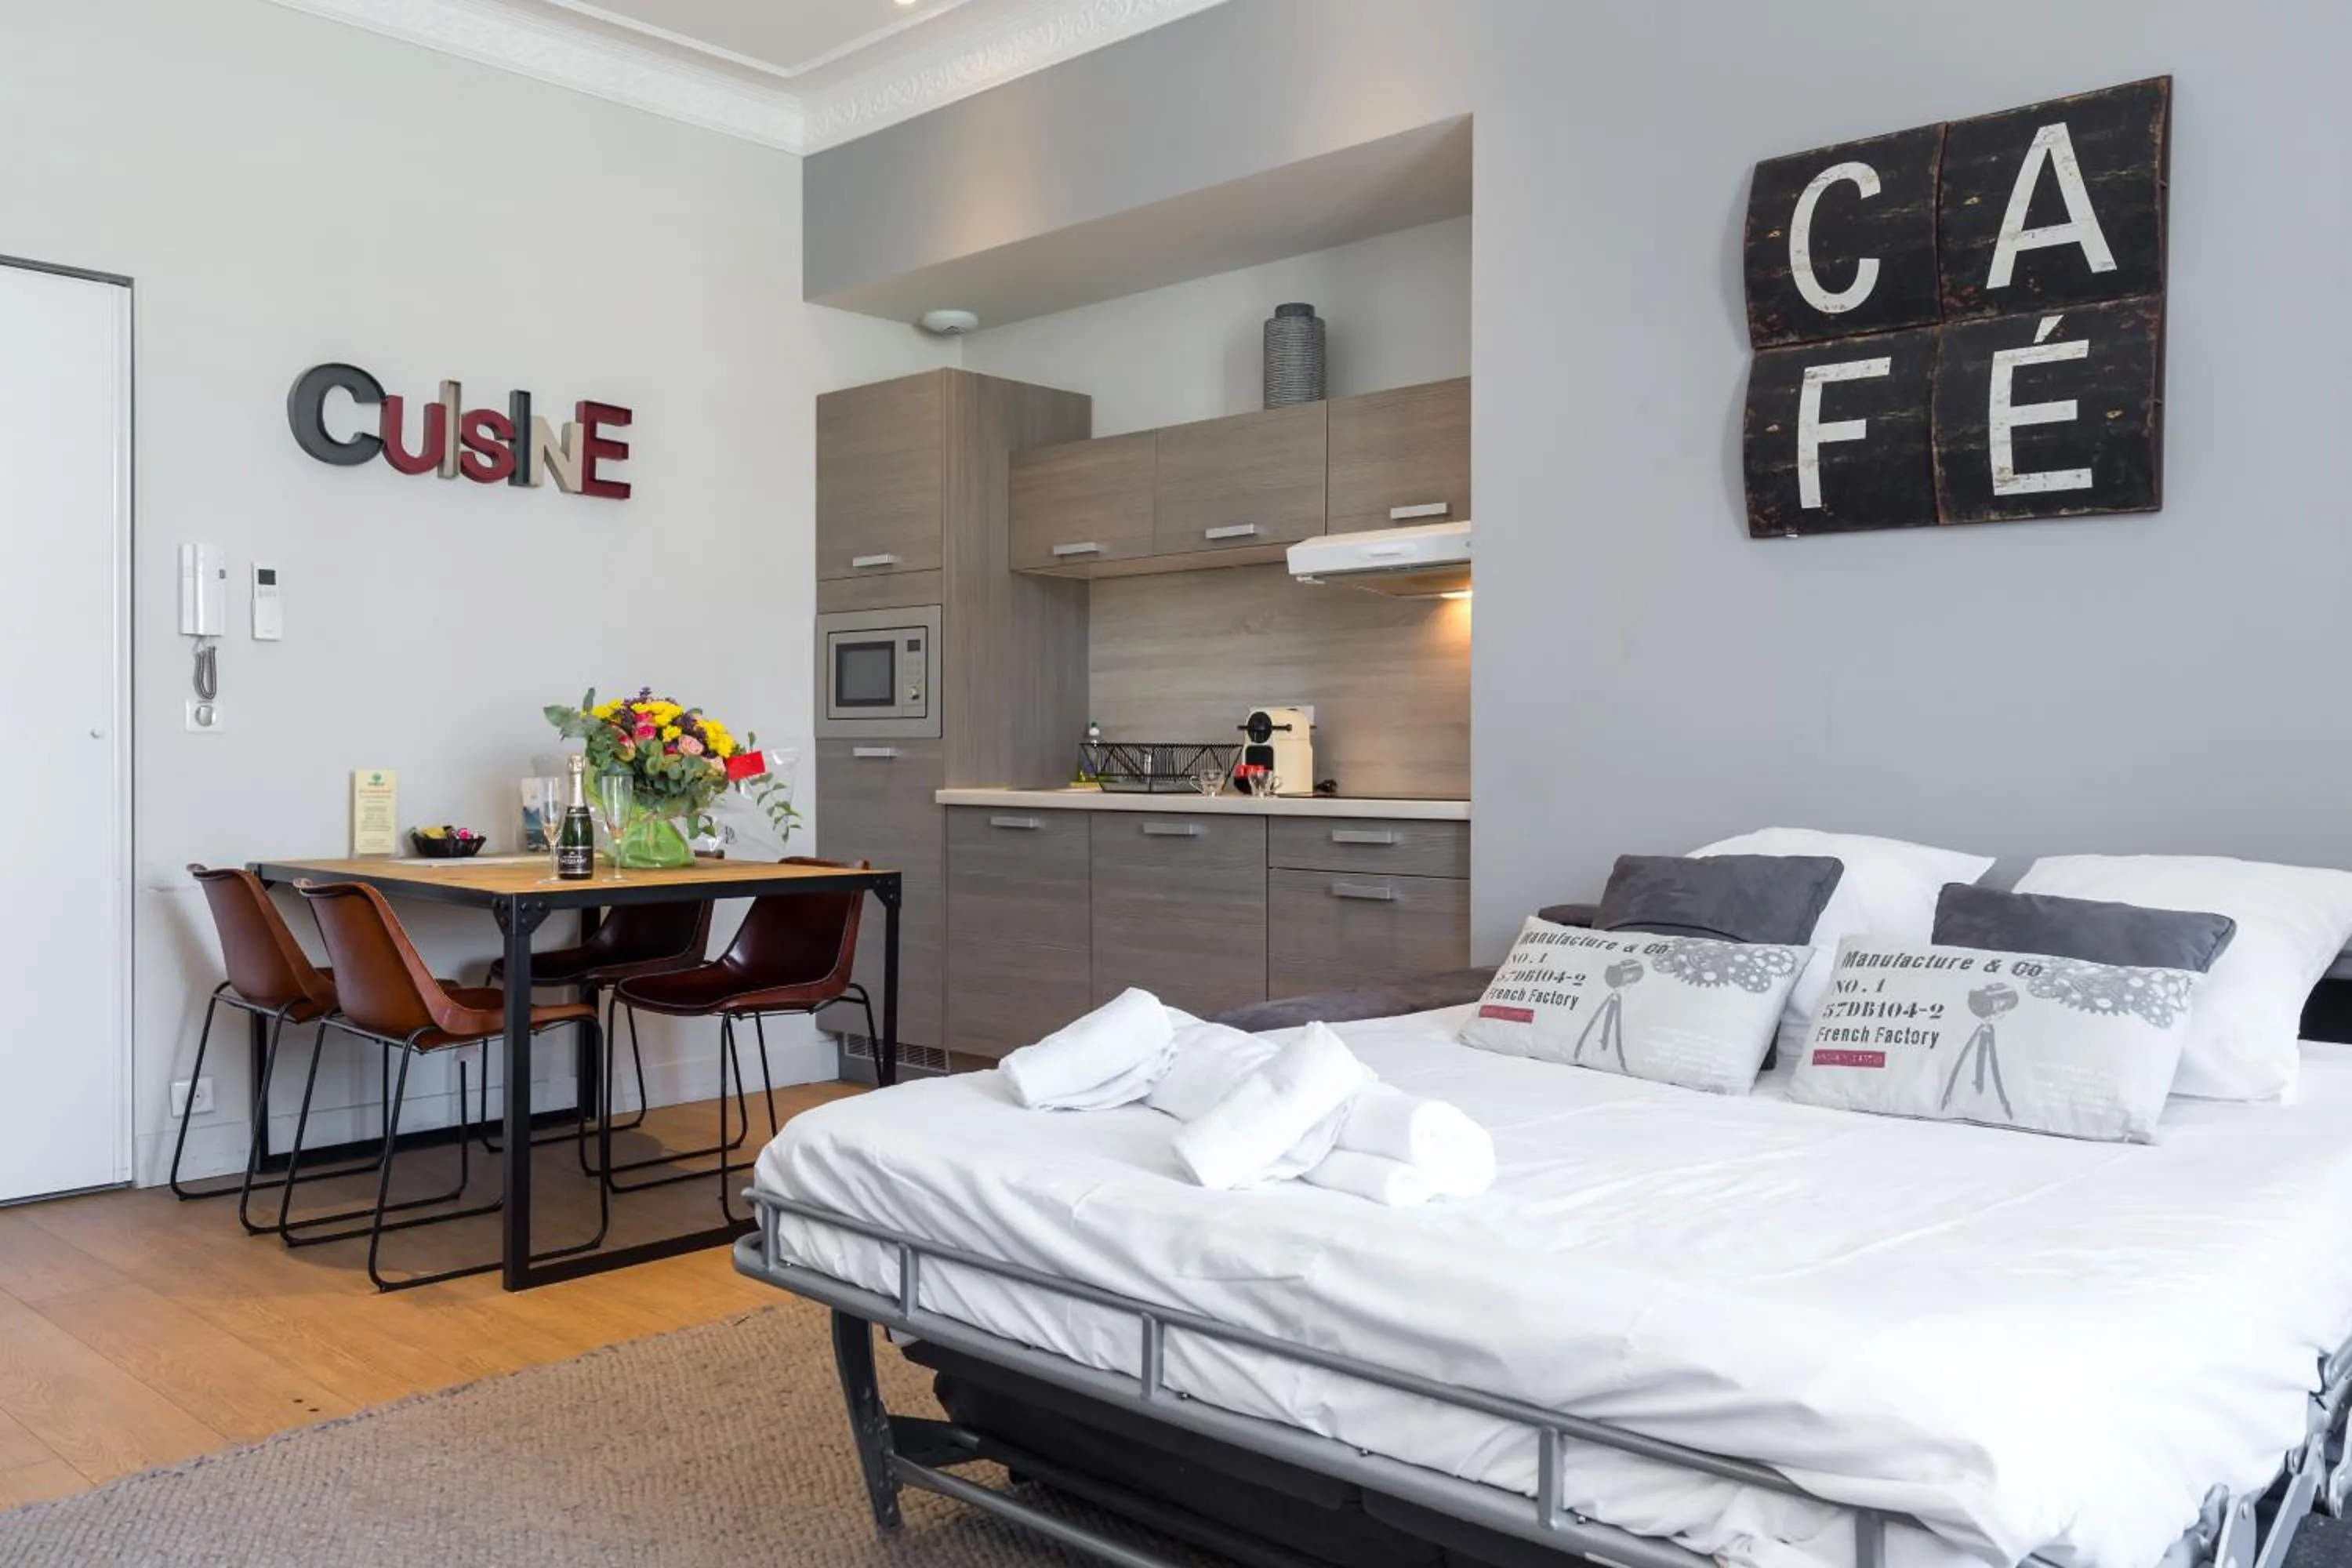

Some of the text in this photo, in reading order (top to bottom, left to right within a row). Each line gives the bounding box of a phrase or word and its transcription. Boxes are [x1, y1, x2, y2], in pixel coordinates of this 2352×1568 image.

[287, 362, 632, 499] CUISINE
[1842, 950, 1975, 971] Manufacture
[1984, 959, 2002, 973] &
[1528, 989, 1580, 1011] Factory
[1815, 1025, 1940, 1050] French Factory
